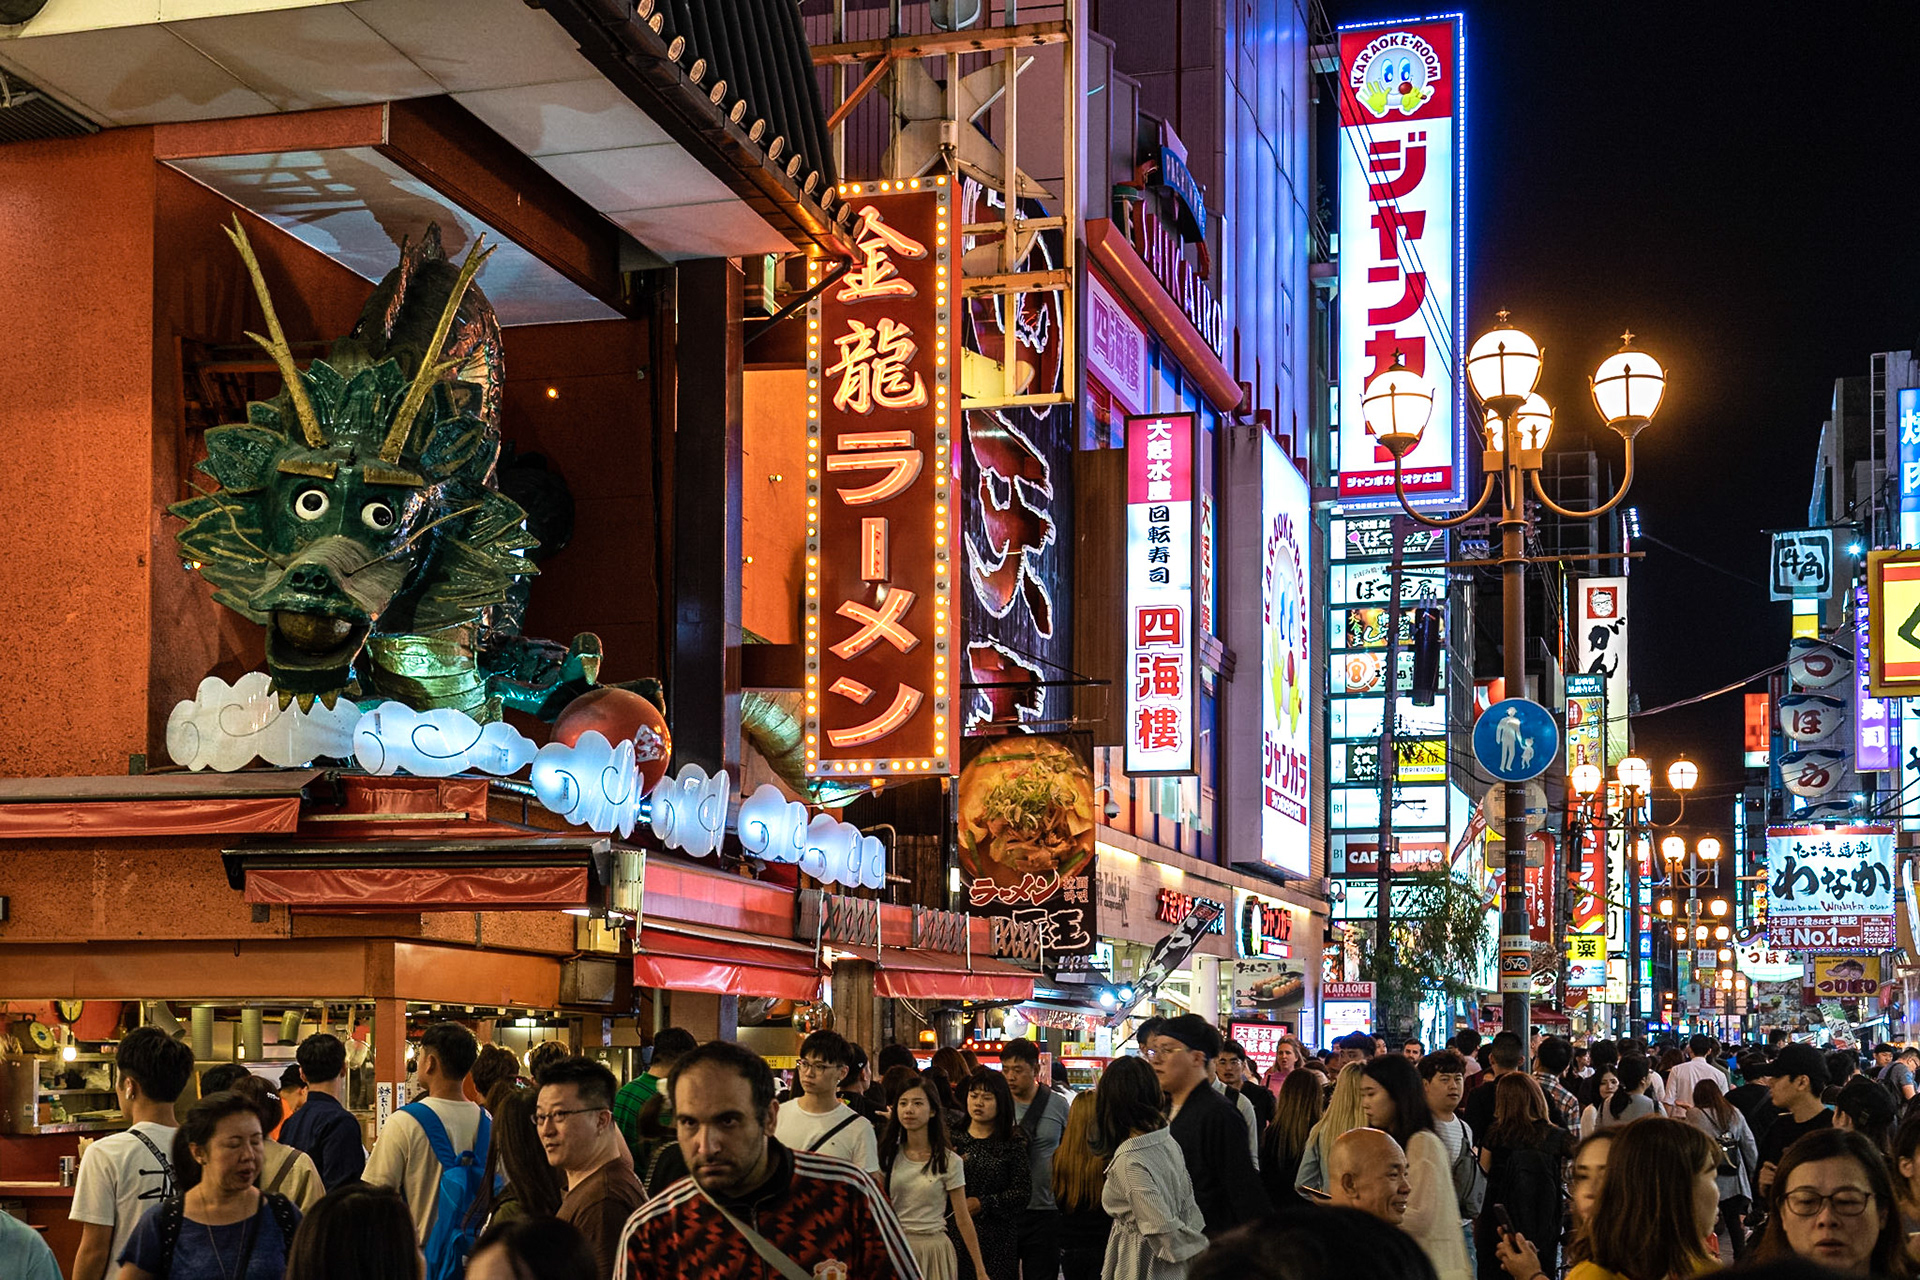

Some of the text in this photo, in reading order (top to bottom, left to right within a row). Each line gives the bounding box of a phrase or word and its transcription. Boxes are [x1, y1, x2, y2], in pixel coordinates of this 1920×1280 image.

[826, 204, 929, 748] 金龍ラーメン
[1346, 471, 1443, 489] ジャンボカオケ広場
[1147, 506, 1171, 585] 回転寿司
[1780, 547, 1824, 581] 牛角
[1137, 605, 1183, 751] 四海樓
[1333, 804, 1343, 814] B1
[1333, 849, 1343, 858] B1
[1349, 850, 1380, 864] CAF
[970, 870, 1060, 906] ラーメン
[1772, 856, 1891, 900] わなか
[1263, 902, 1292, 942] ジャンカラ
[1578, 940, 1595, 957] 薬
[1325, 984, 1369, 993] KARAOKE
[1818, 979, 1878, 995] つりぼり
